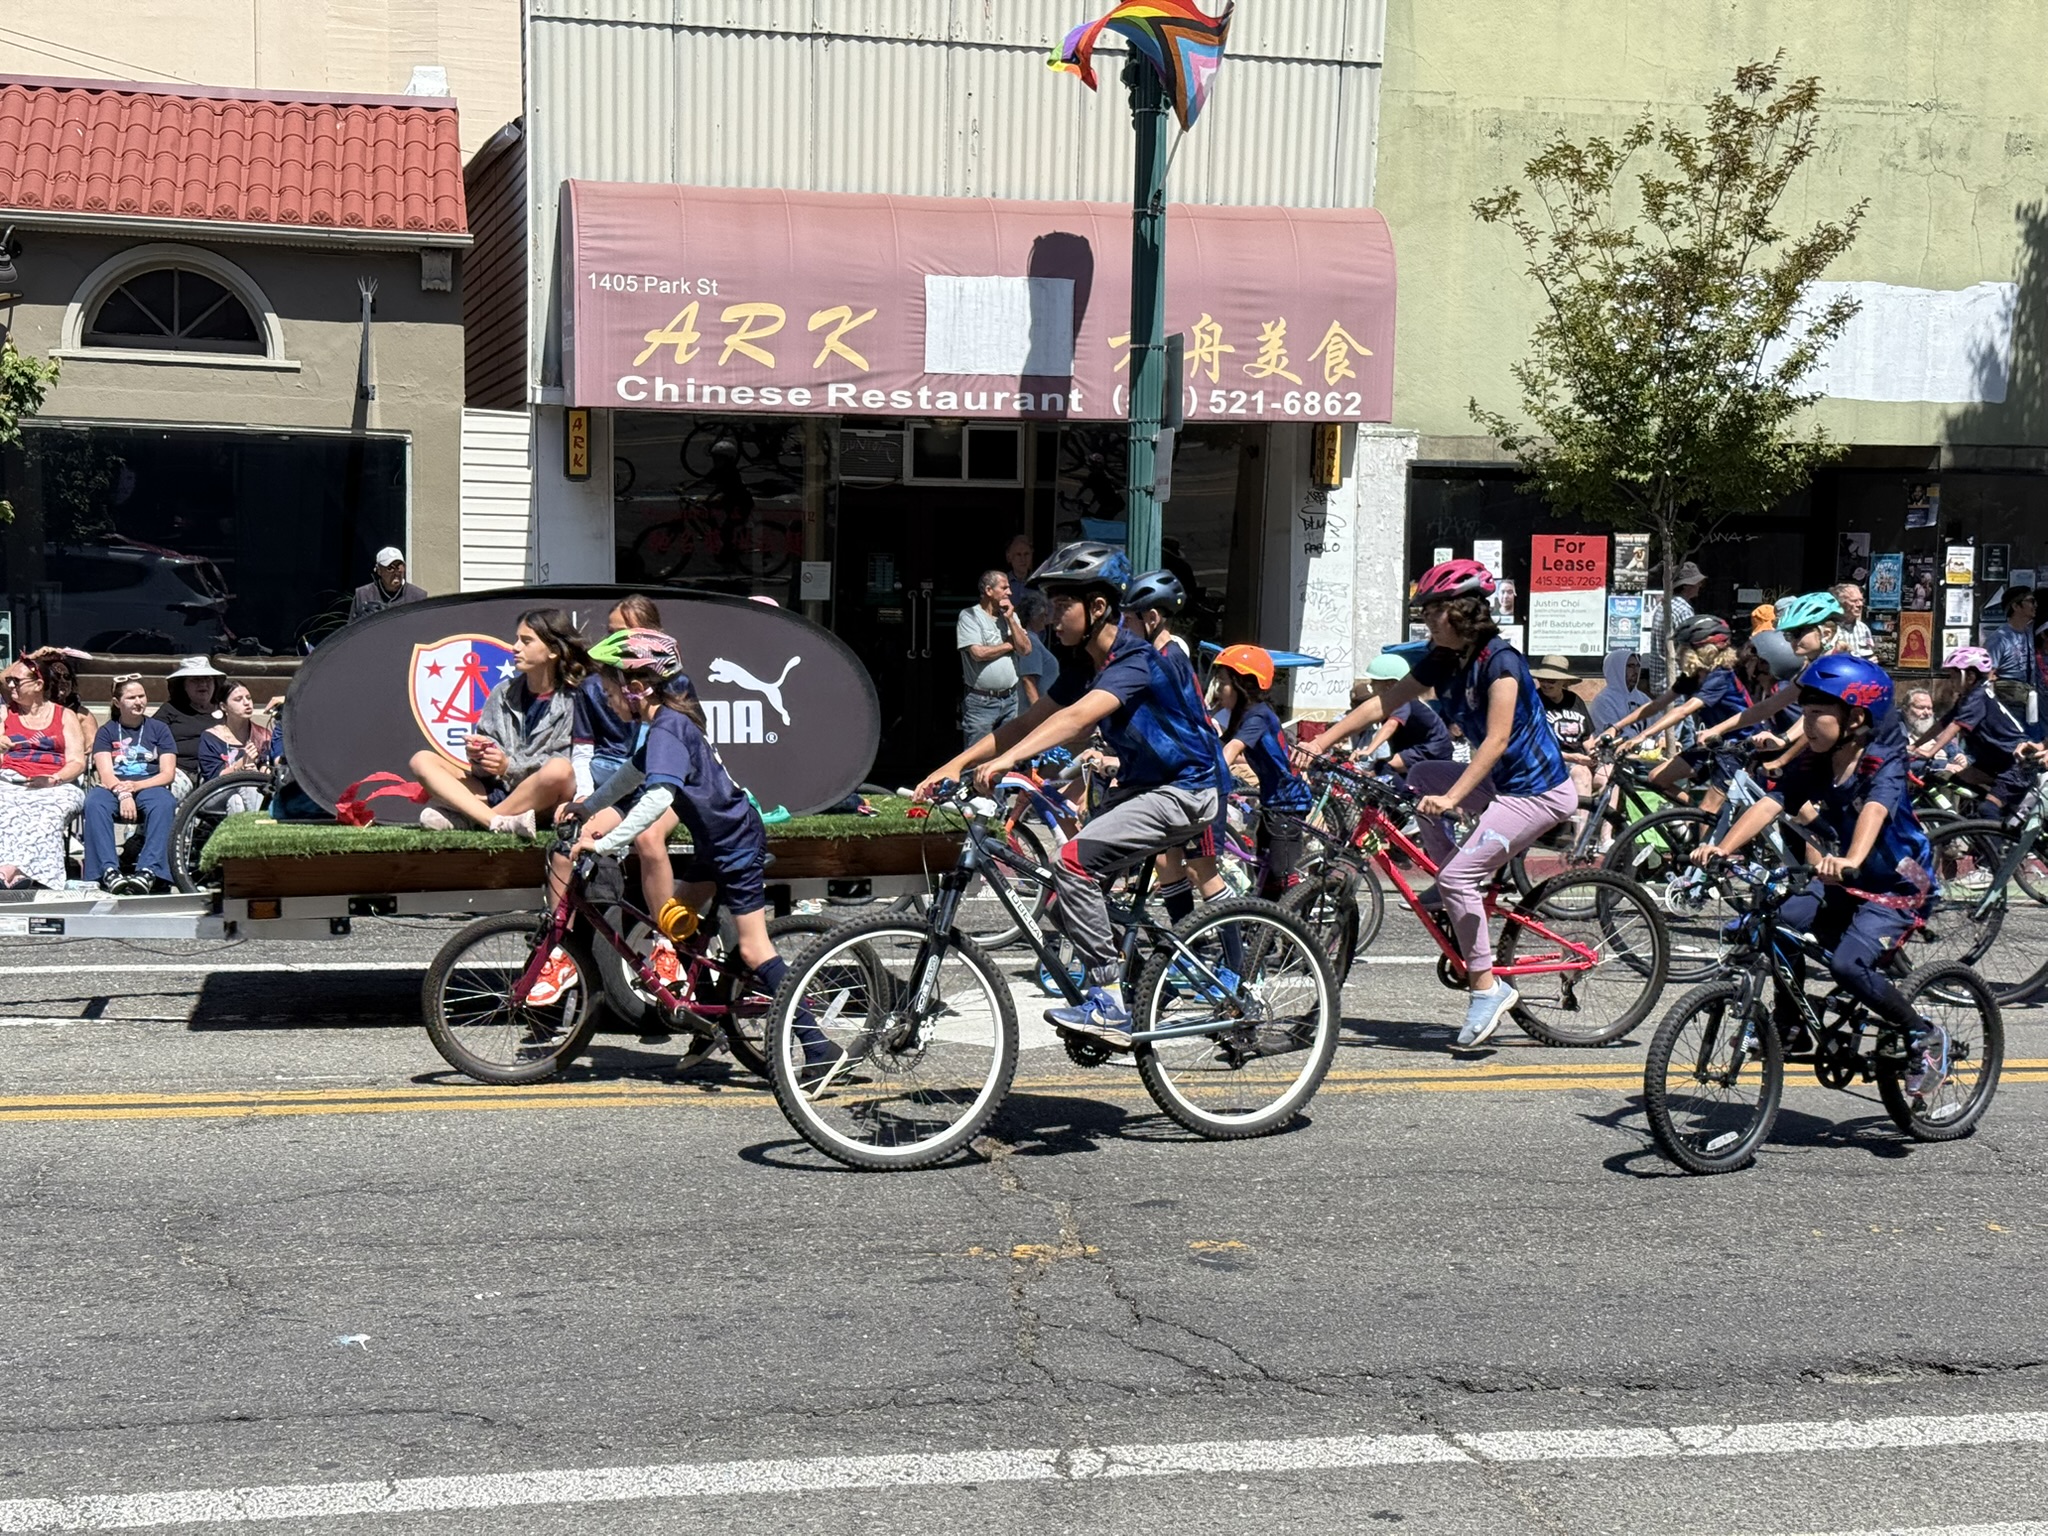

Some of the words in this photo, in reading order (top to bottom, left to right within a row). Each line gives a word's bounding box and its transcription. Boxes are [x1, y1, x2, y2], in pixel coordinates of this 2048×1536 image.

[586, 272, 639, 293] 1405
[643, 275, 692, 296] Park
[696, 278, 719, 297] St
[632, 300, 878, 372] ARK
[616, 374, 812, 407] Chinese
[827, 382, 1083, 413] Restaurant
[1209, 388, 1363, 416] 521-6862
[572, 417, 585, 469] ARK
[1554, 538, 1586, 554] For
[1542, 556, 1596, 572] Lease
[1535, 576, 1603, 587] 415.395.7262
[1534, 600, 1559, 608] Justin
[1560, 599, 1581, 608] Choi
[1533, 620, 1549, 628] Jeff
[1550, 620, 1595, 628] Badstubner
[699, 700, 764, 744] MA
